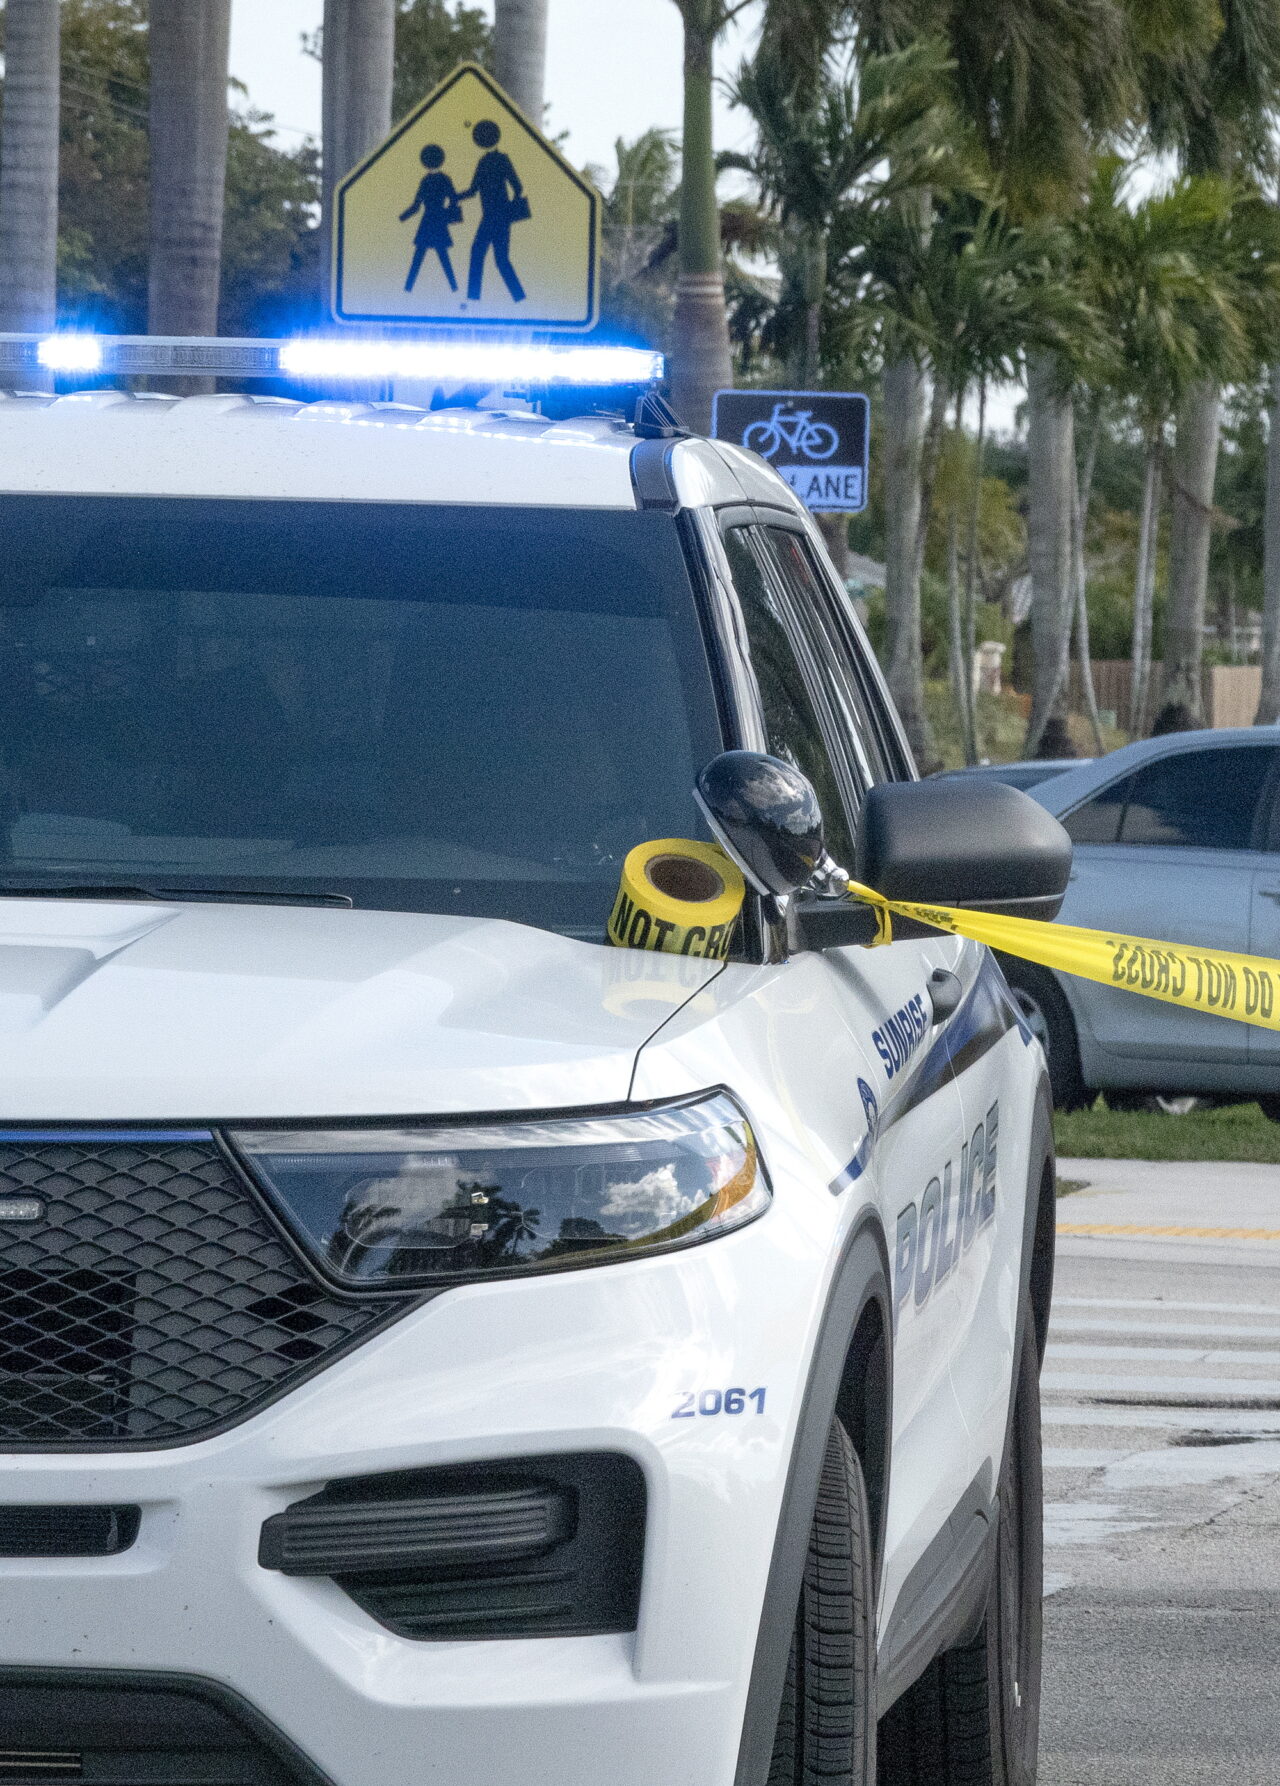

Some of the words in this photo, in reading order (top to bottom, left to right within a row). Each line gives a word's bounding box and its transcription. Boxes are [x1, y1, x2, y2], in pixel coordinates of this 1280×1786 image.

[614, 892, 676, 952] NOT
[872, 994, 927, 1079] SUNRISE
[892, 1099, 999, 1337] POLICE
[671, 1387, 766, 1419] 2061
